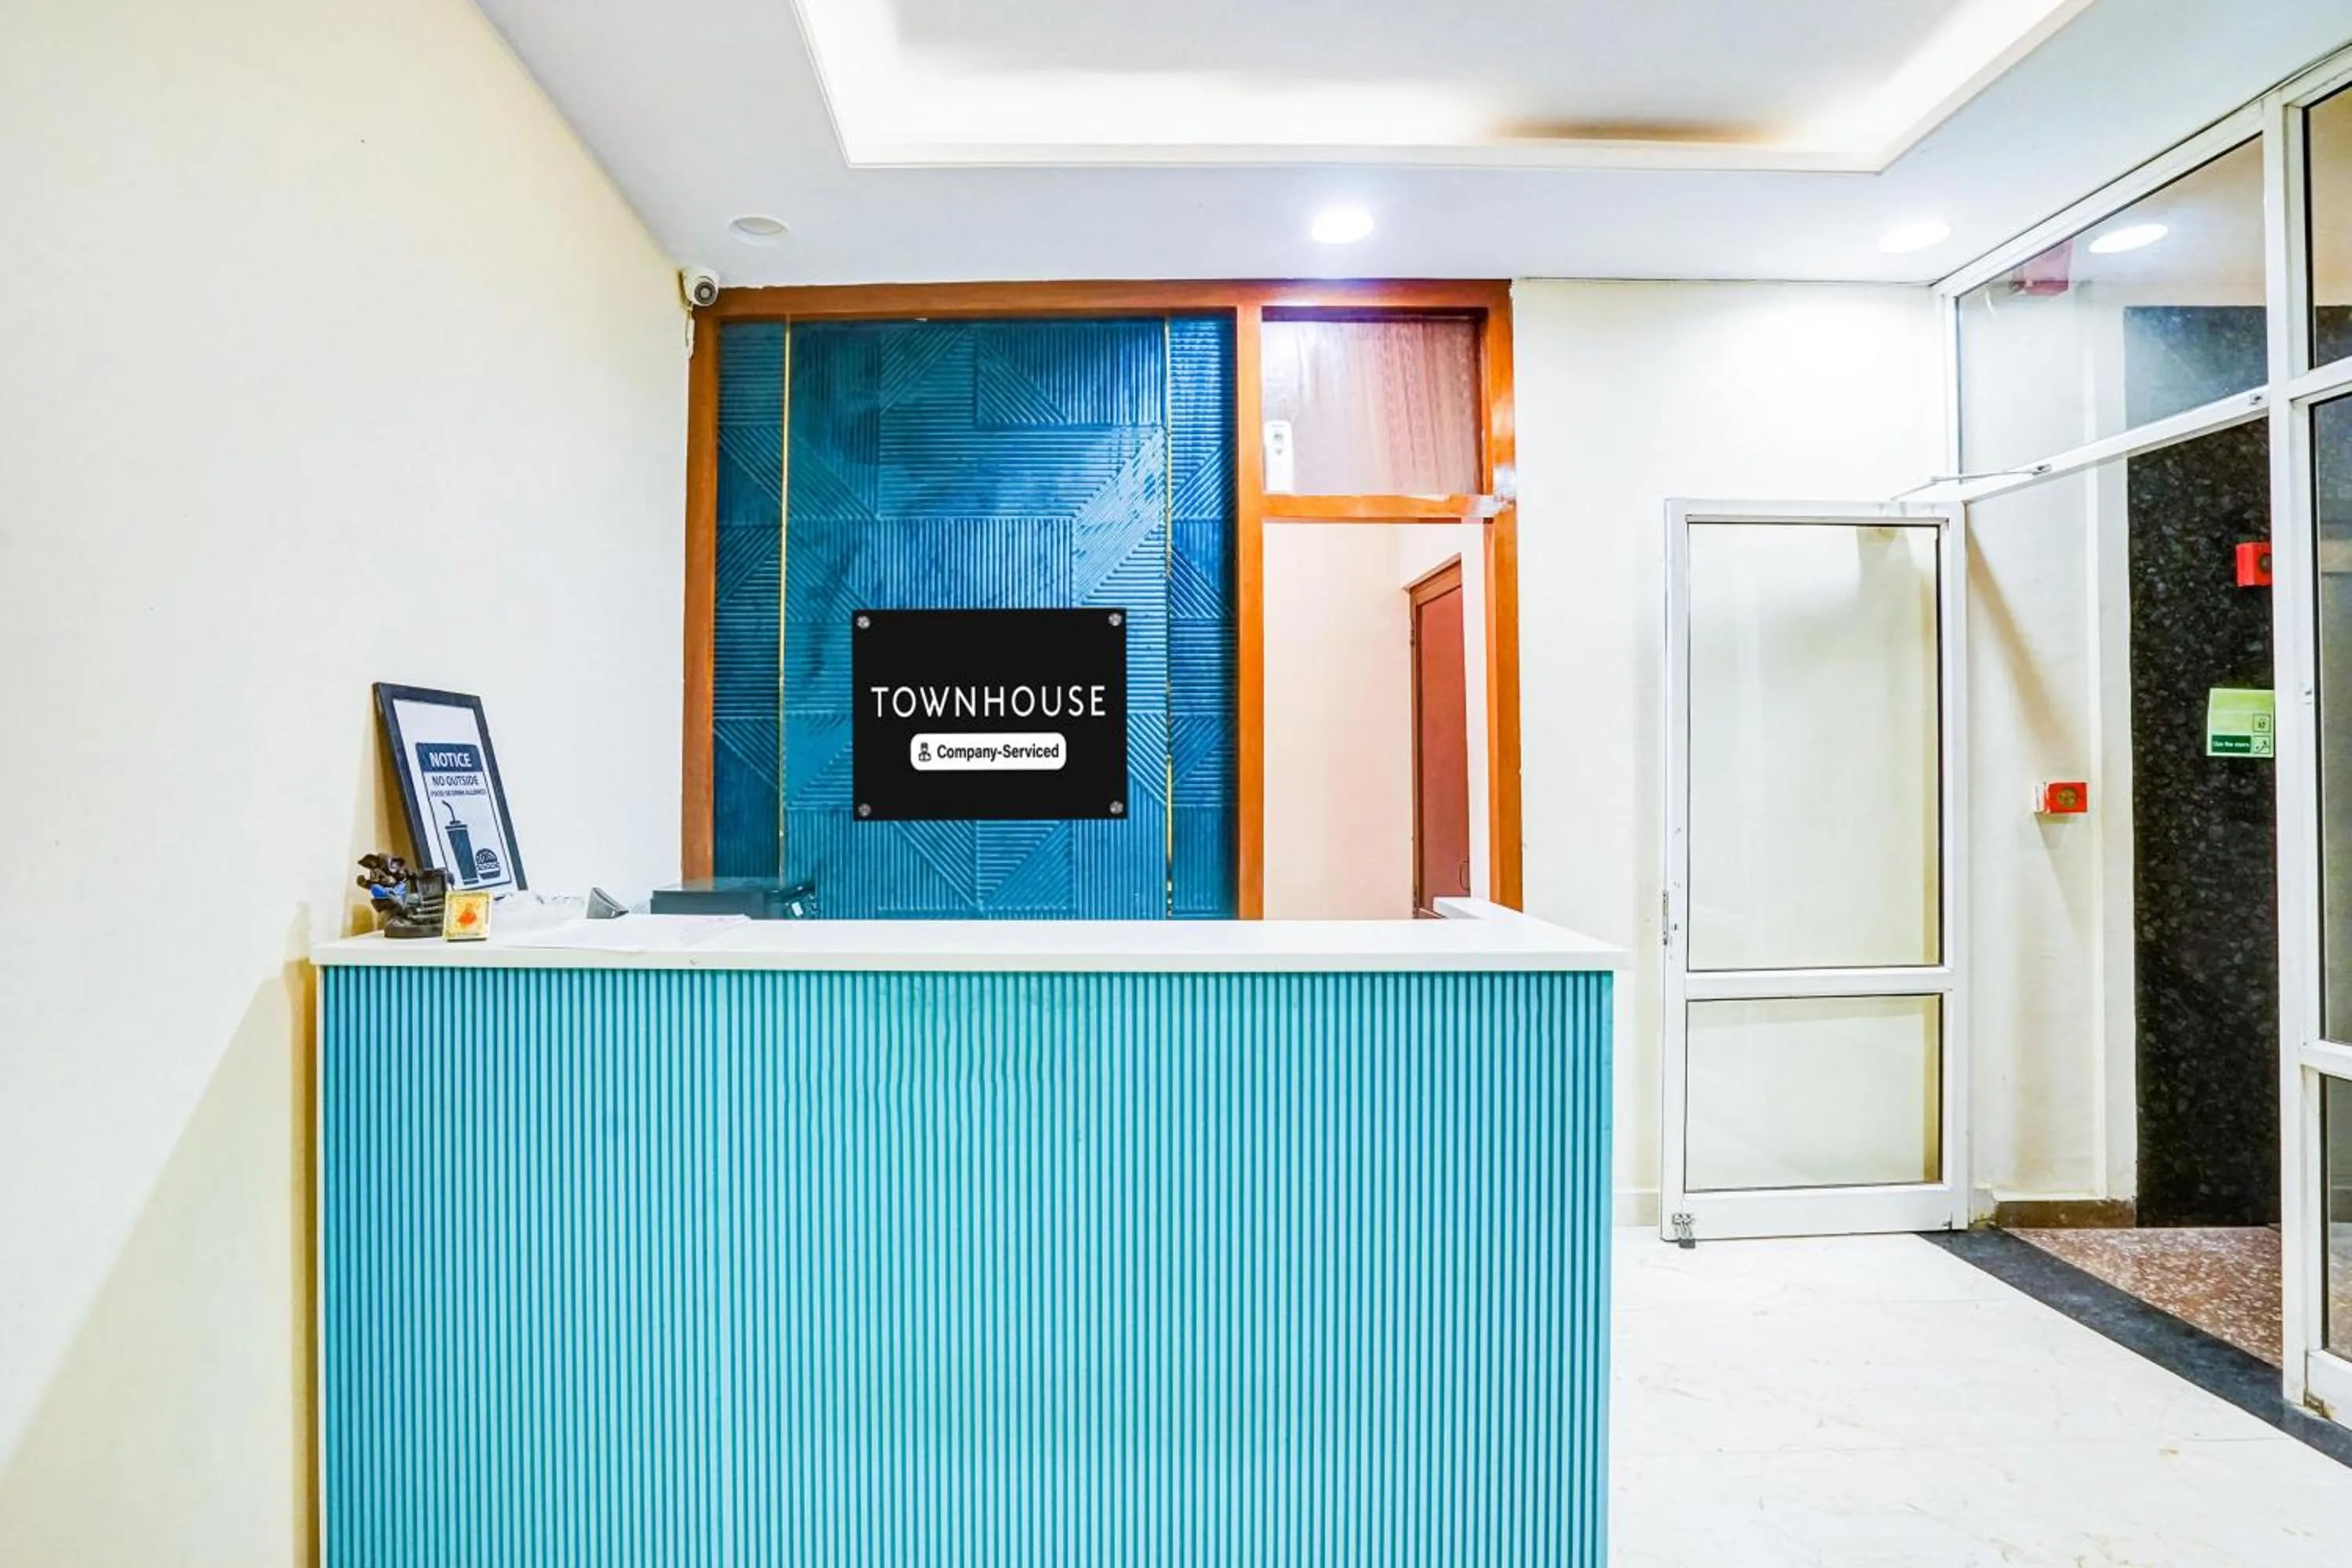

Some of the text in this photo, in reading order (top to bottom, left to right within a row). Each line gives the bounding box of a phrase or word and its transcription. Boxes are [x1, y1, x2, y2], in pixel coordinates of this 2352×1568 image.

[870, 685, 1106, 717] TOWNHOUSE
[429, 752, 473, 768] NOTICE
[937, 743, 1059, 762] Company-Serviced
[431, 775, 479, 786] NO OUTSIDE
